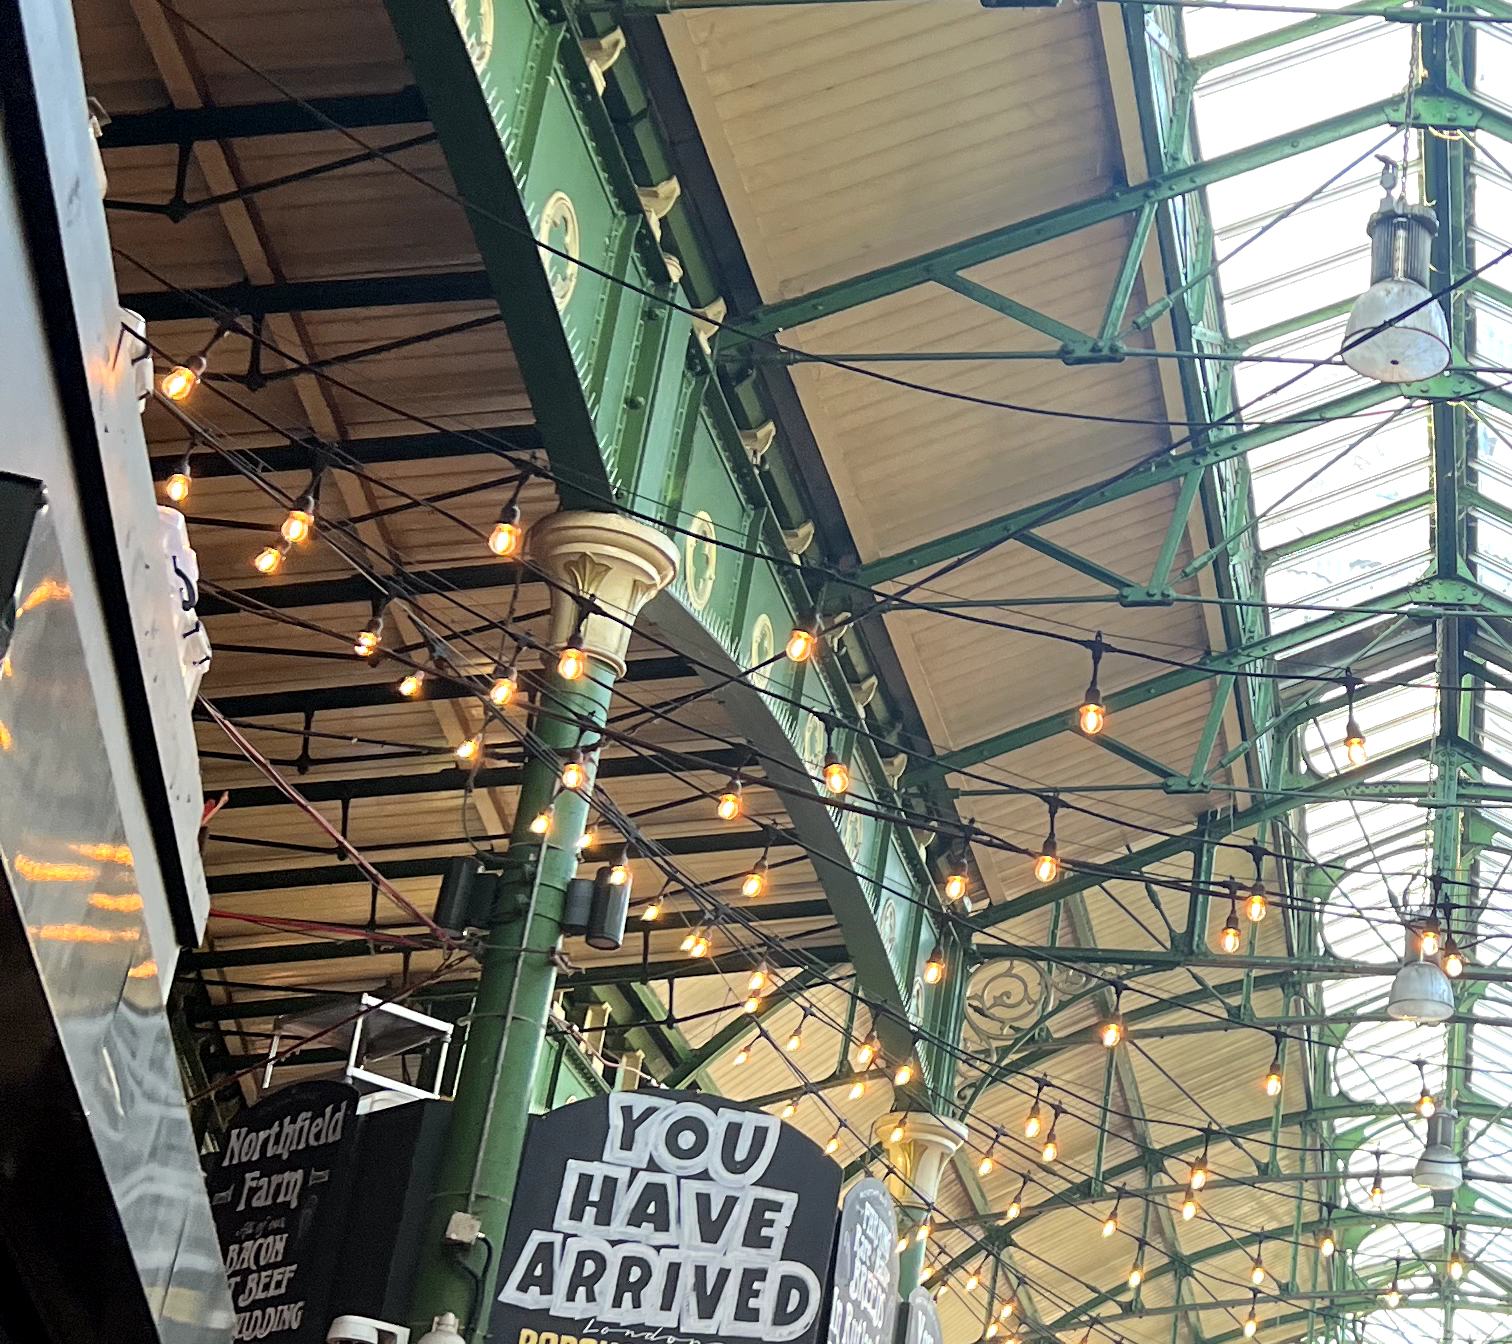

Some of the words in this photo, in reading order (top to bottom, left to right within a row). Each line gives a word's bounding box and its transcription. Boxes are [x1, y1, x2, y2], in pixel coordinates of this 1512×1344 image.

[222, 1101, 348, 1166] Northfield
[606, 1094, 779, 1186] YOU
[236, 1168, 305, 1211] Farm
[556, 1161, 797, 1255] HAVE
[226, 1233, 290, 1276] BACON
[238, 1264, 299, 1308] BEEF
[501, 1232, 819, 1340] ARRIVED
